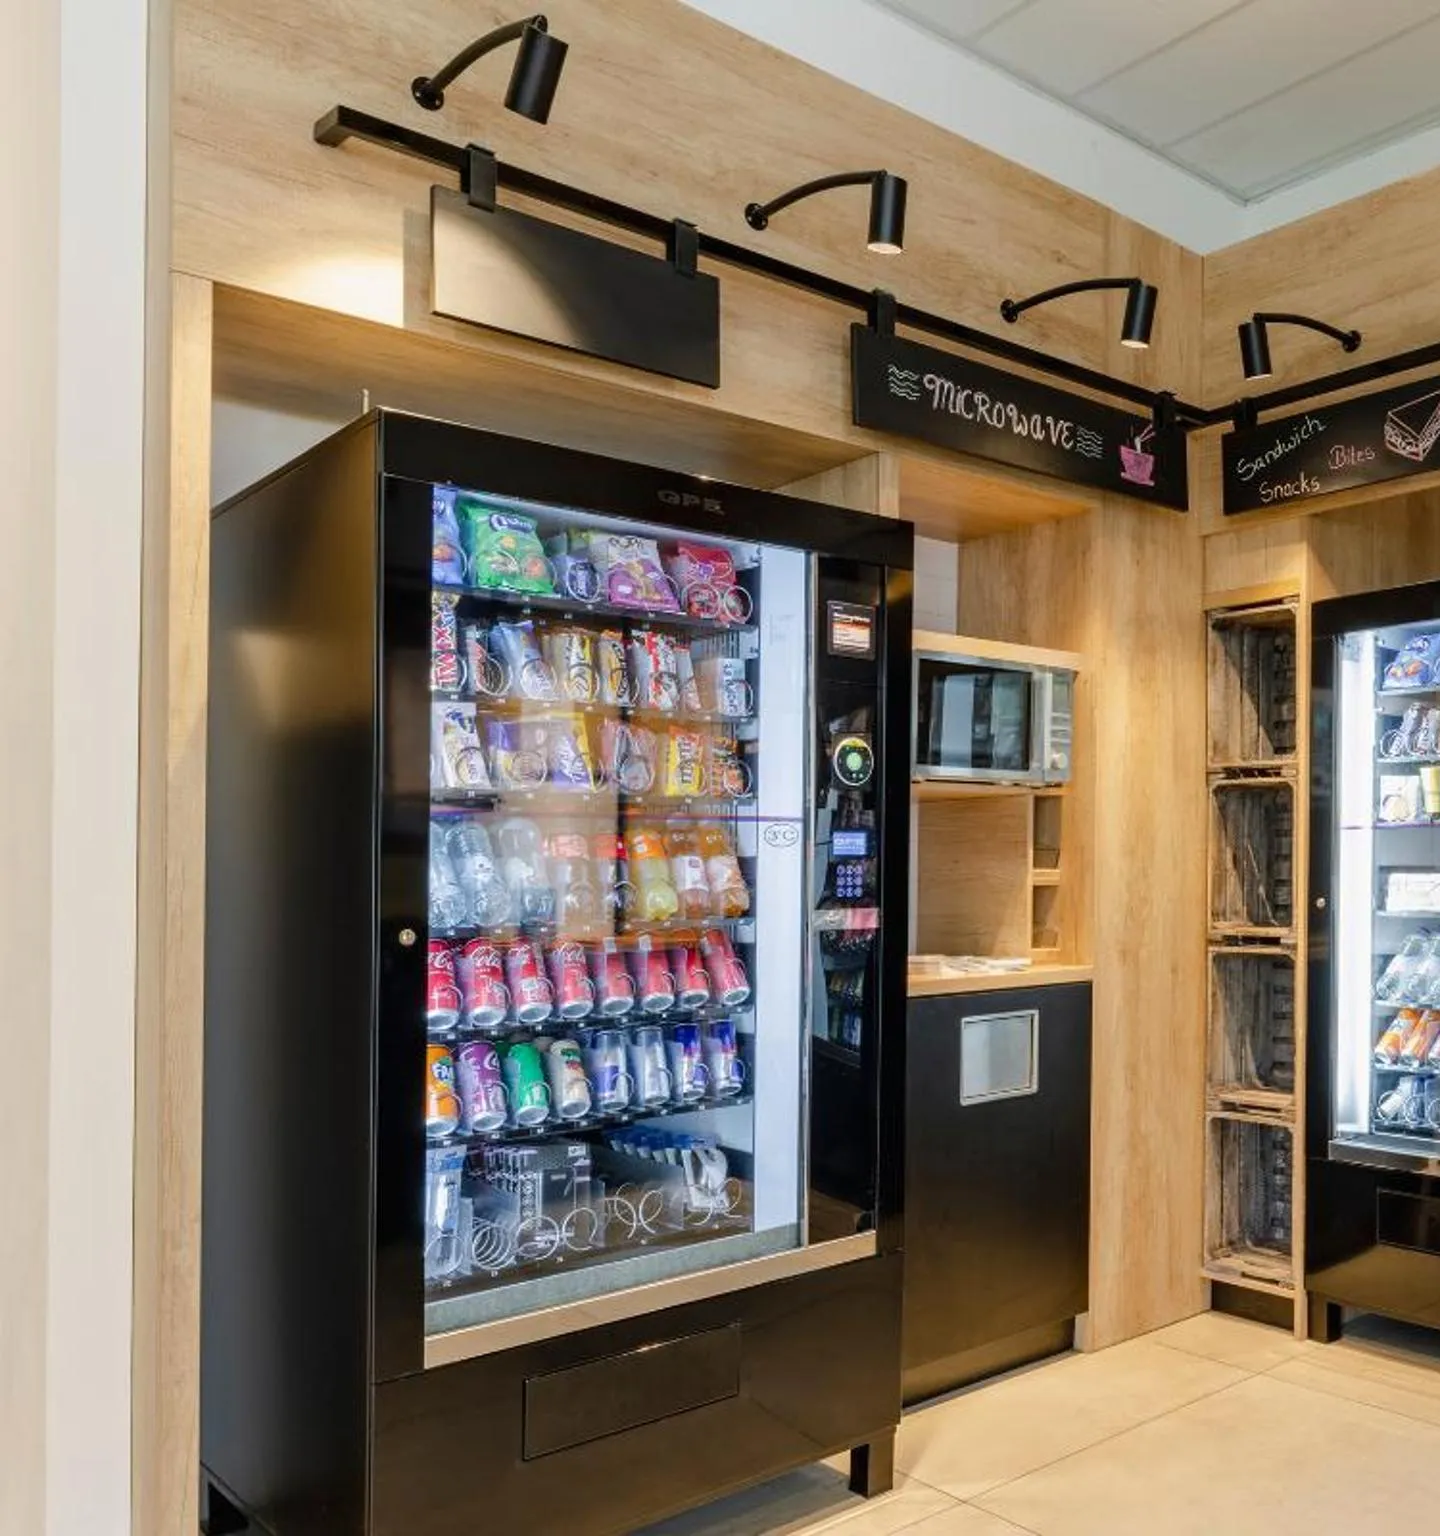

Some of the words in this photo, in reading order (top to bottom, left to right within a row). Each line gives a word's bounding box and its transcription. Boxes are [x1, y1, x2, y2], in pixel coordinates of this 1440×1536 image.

[1235, 414, 1330, 482] Sandwich
[1328, 444, 1377, 471] Bites
[1258, 473, 1322, 504] Snacks
